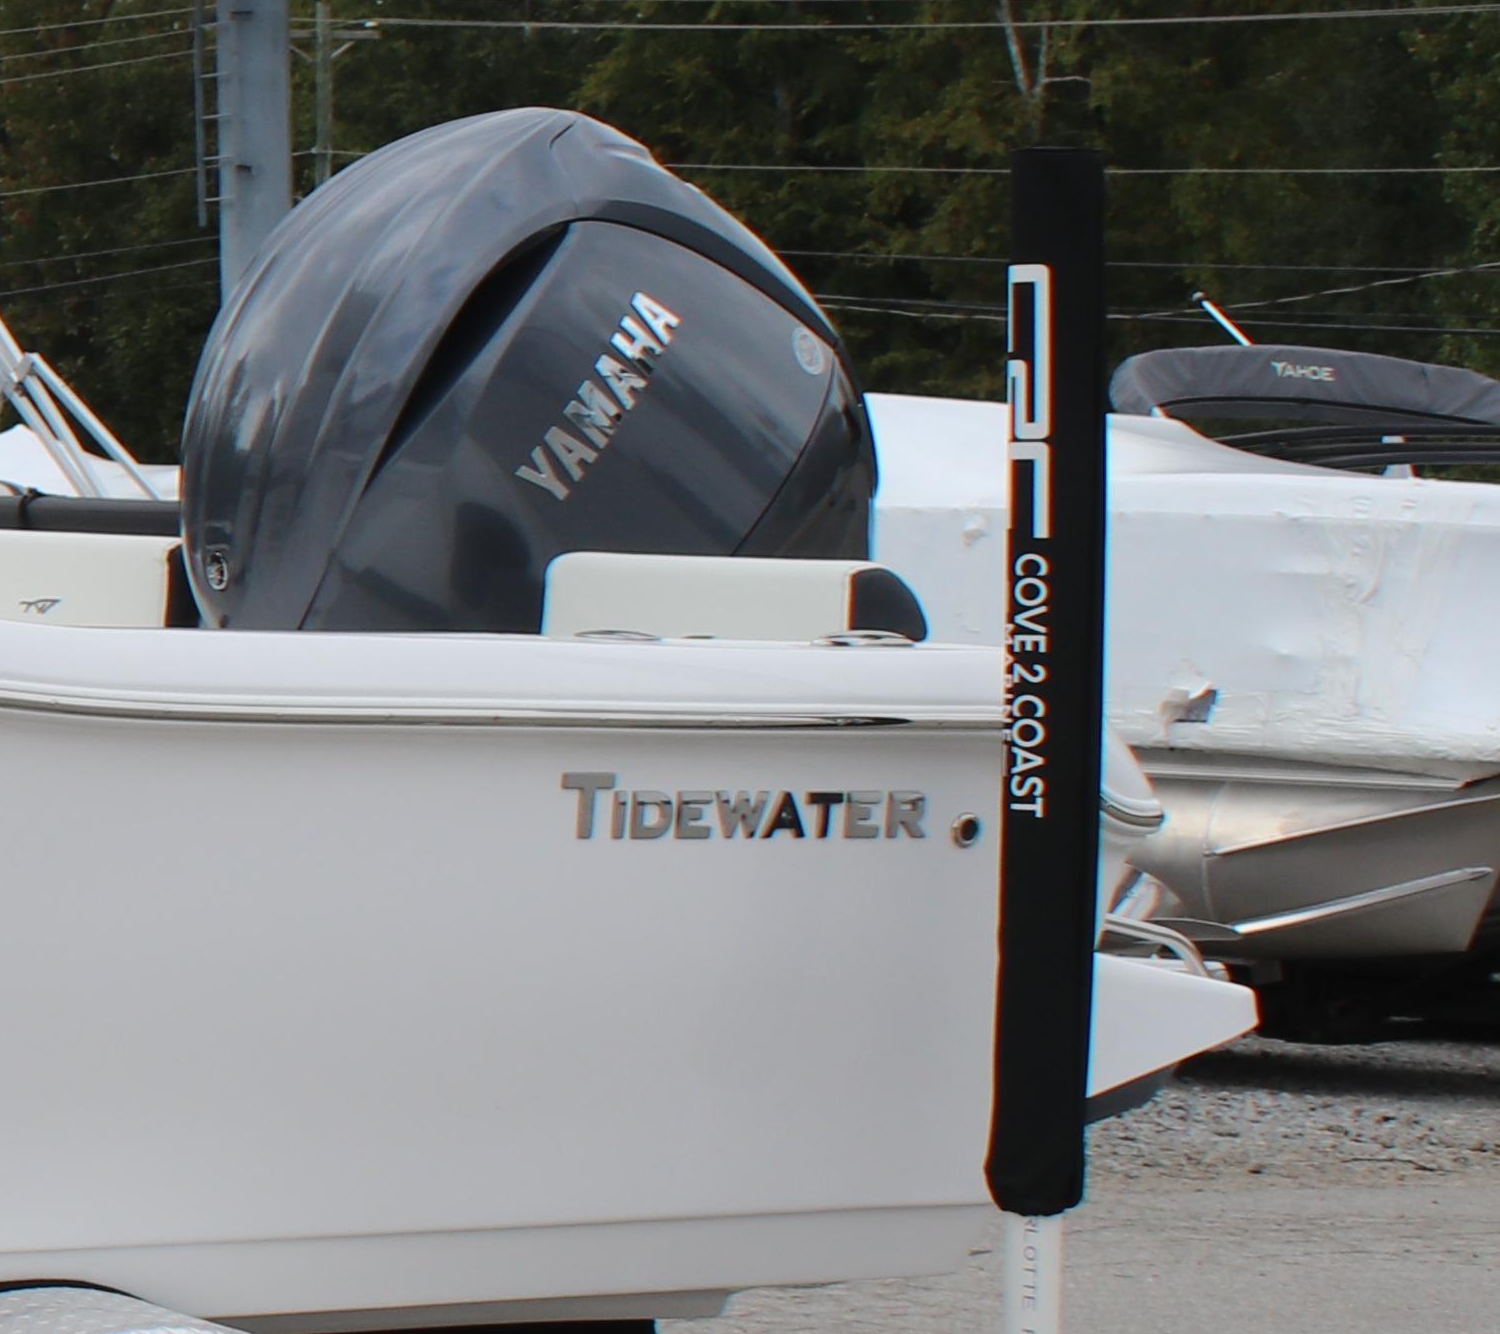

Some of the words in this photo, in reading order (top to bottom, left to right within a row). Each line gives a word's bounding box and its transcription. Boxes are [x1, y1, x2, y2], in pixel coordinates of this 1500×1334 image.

[514, 290, 684, 501] YAMAHA
[1270, 361, 1336, 381] TAHOE
[1012, 553, 1049, 653] COVE
[1011, 663, 1047, 684] 2
[1010, 694, 1046, 819] COAST
[561, 771, 927, 840] TIDEWATER
